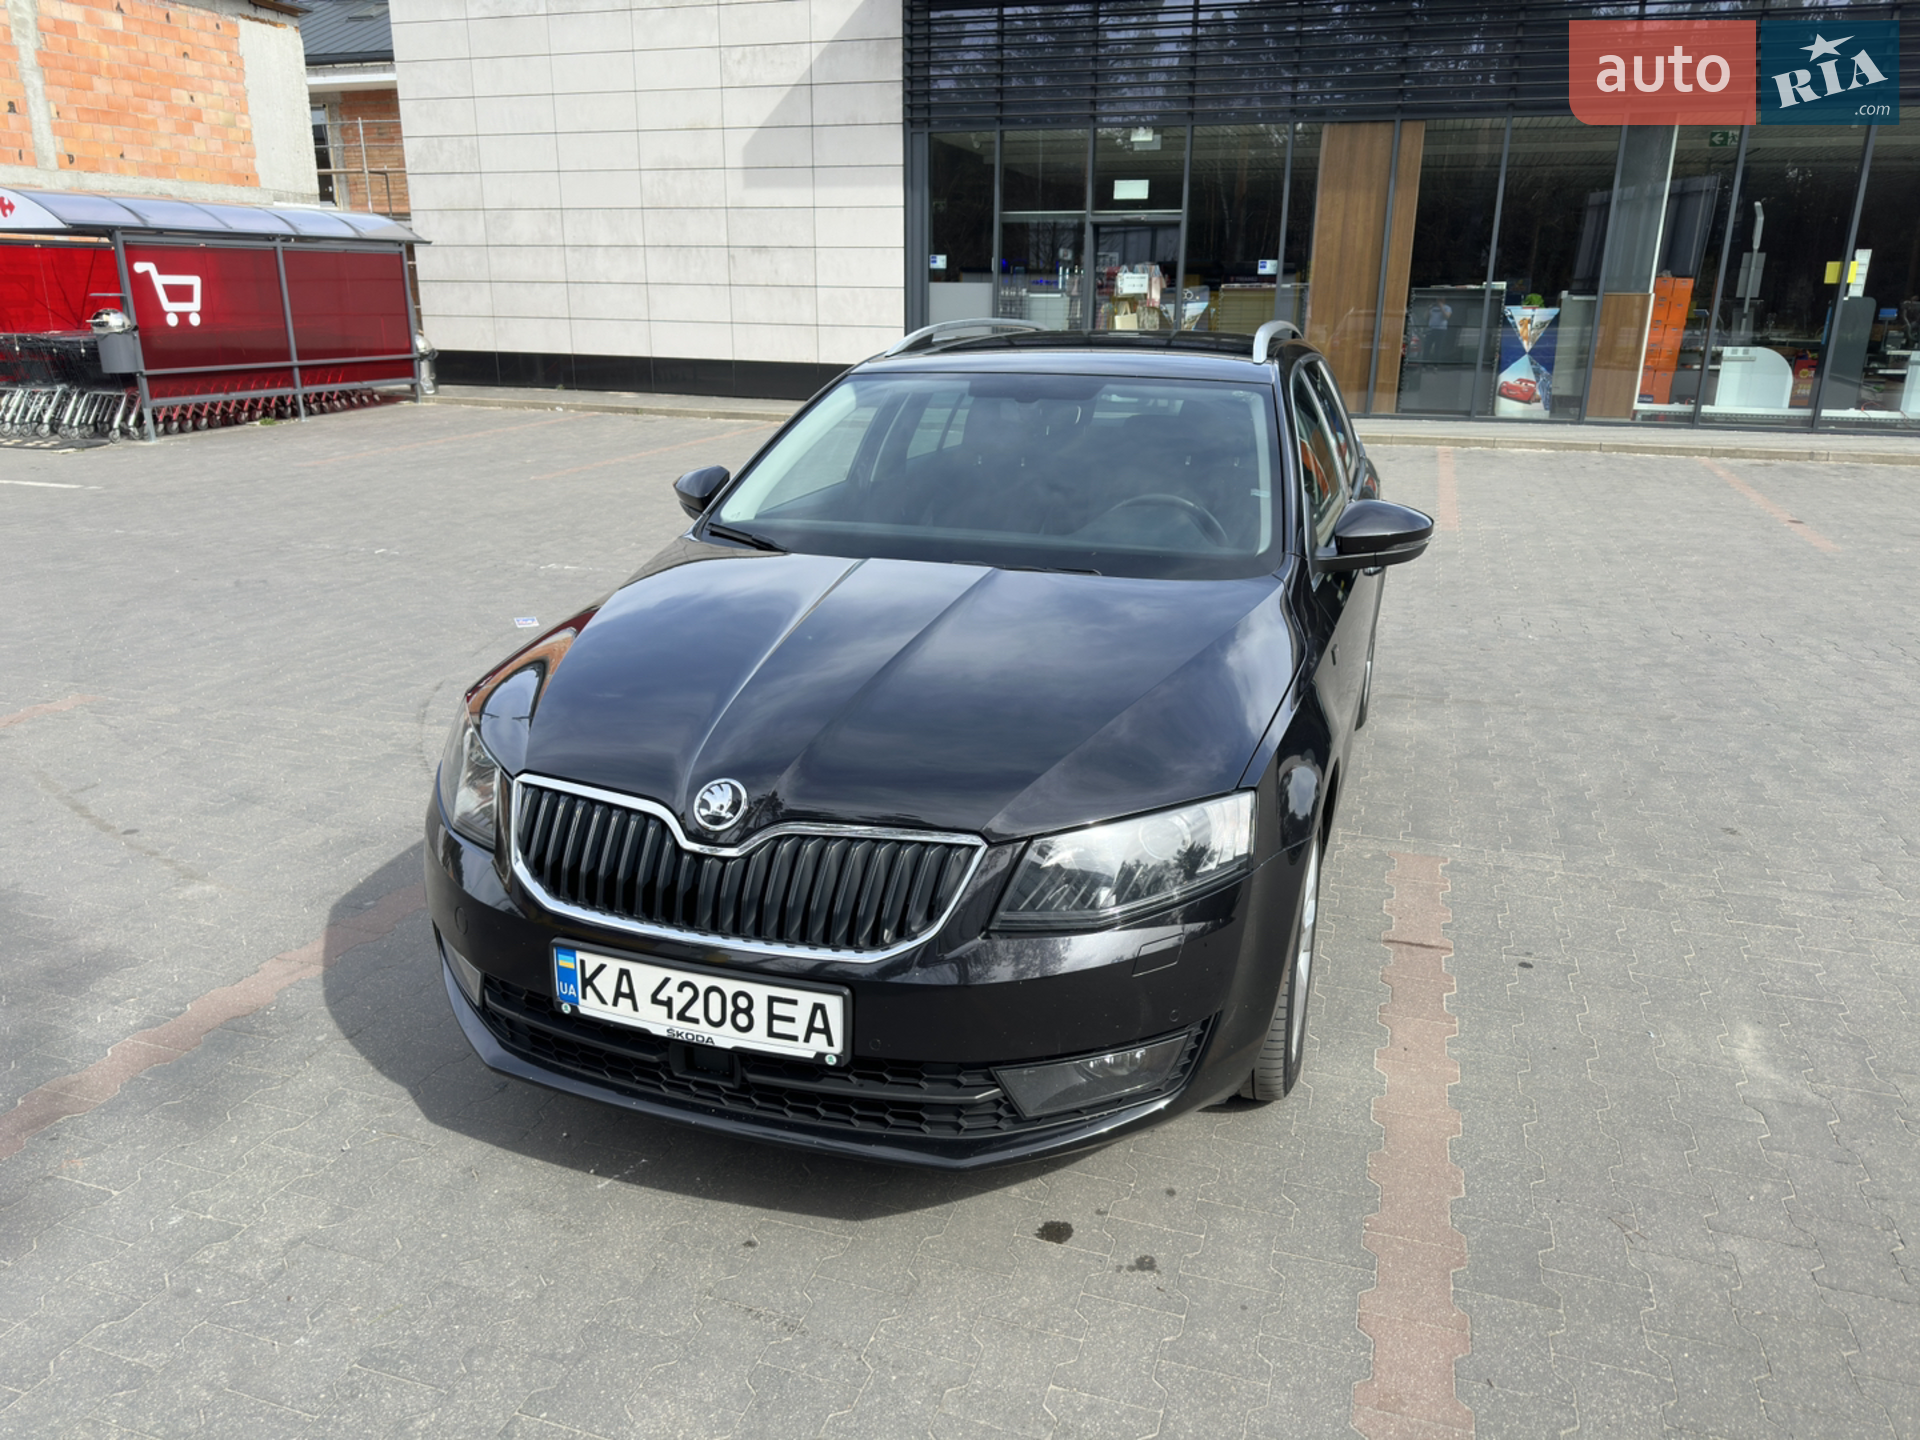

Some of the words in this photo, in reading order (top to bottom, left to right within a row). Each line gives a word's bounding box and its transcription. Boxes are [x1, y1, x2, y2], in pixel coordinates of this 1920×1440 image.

[559, 981, 577, 998] UA
[580, 959, 638, 1012] KA
[651, 977, 754, 1033] 4208
[767, 995, 834, 1047] EA
